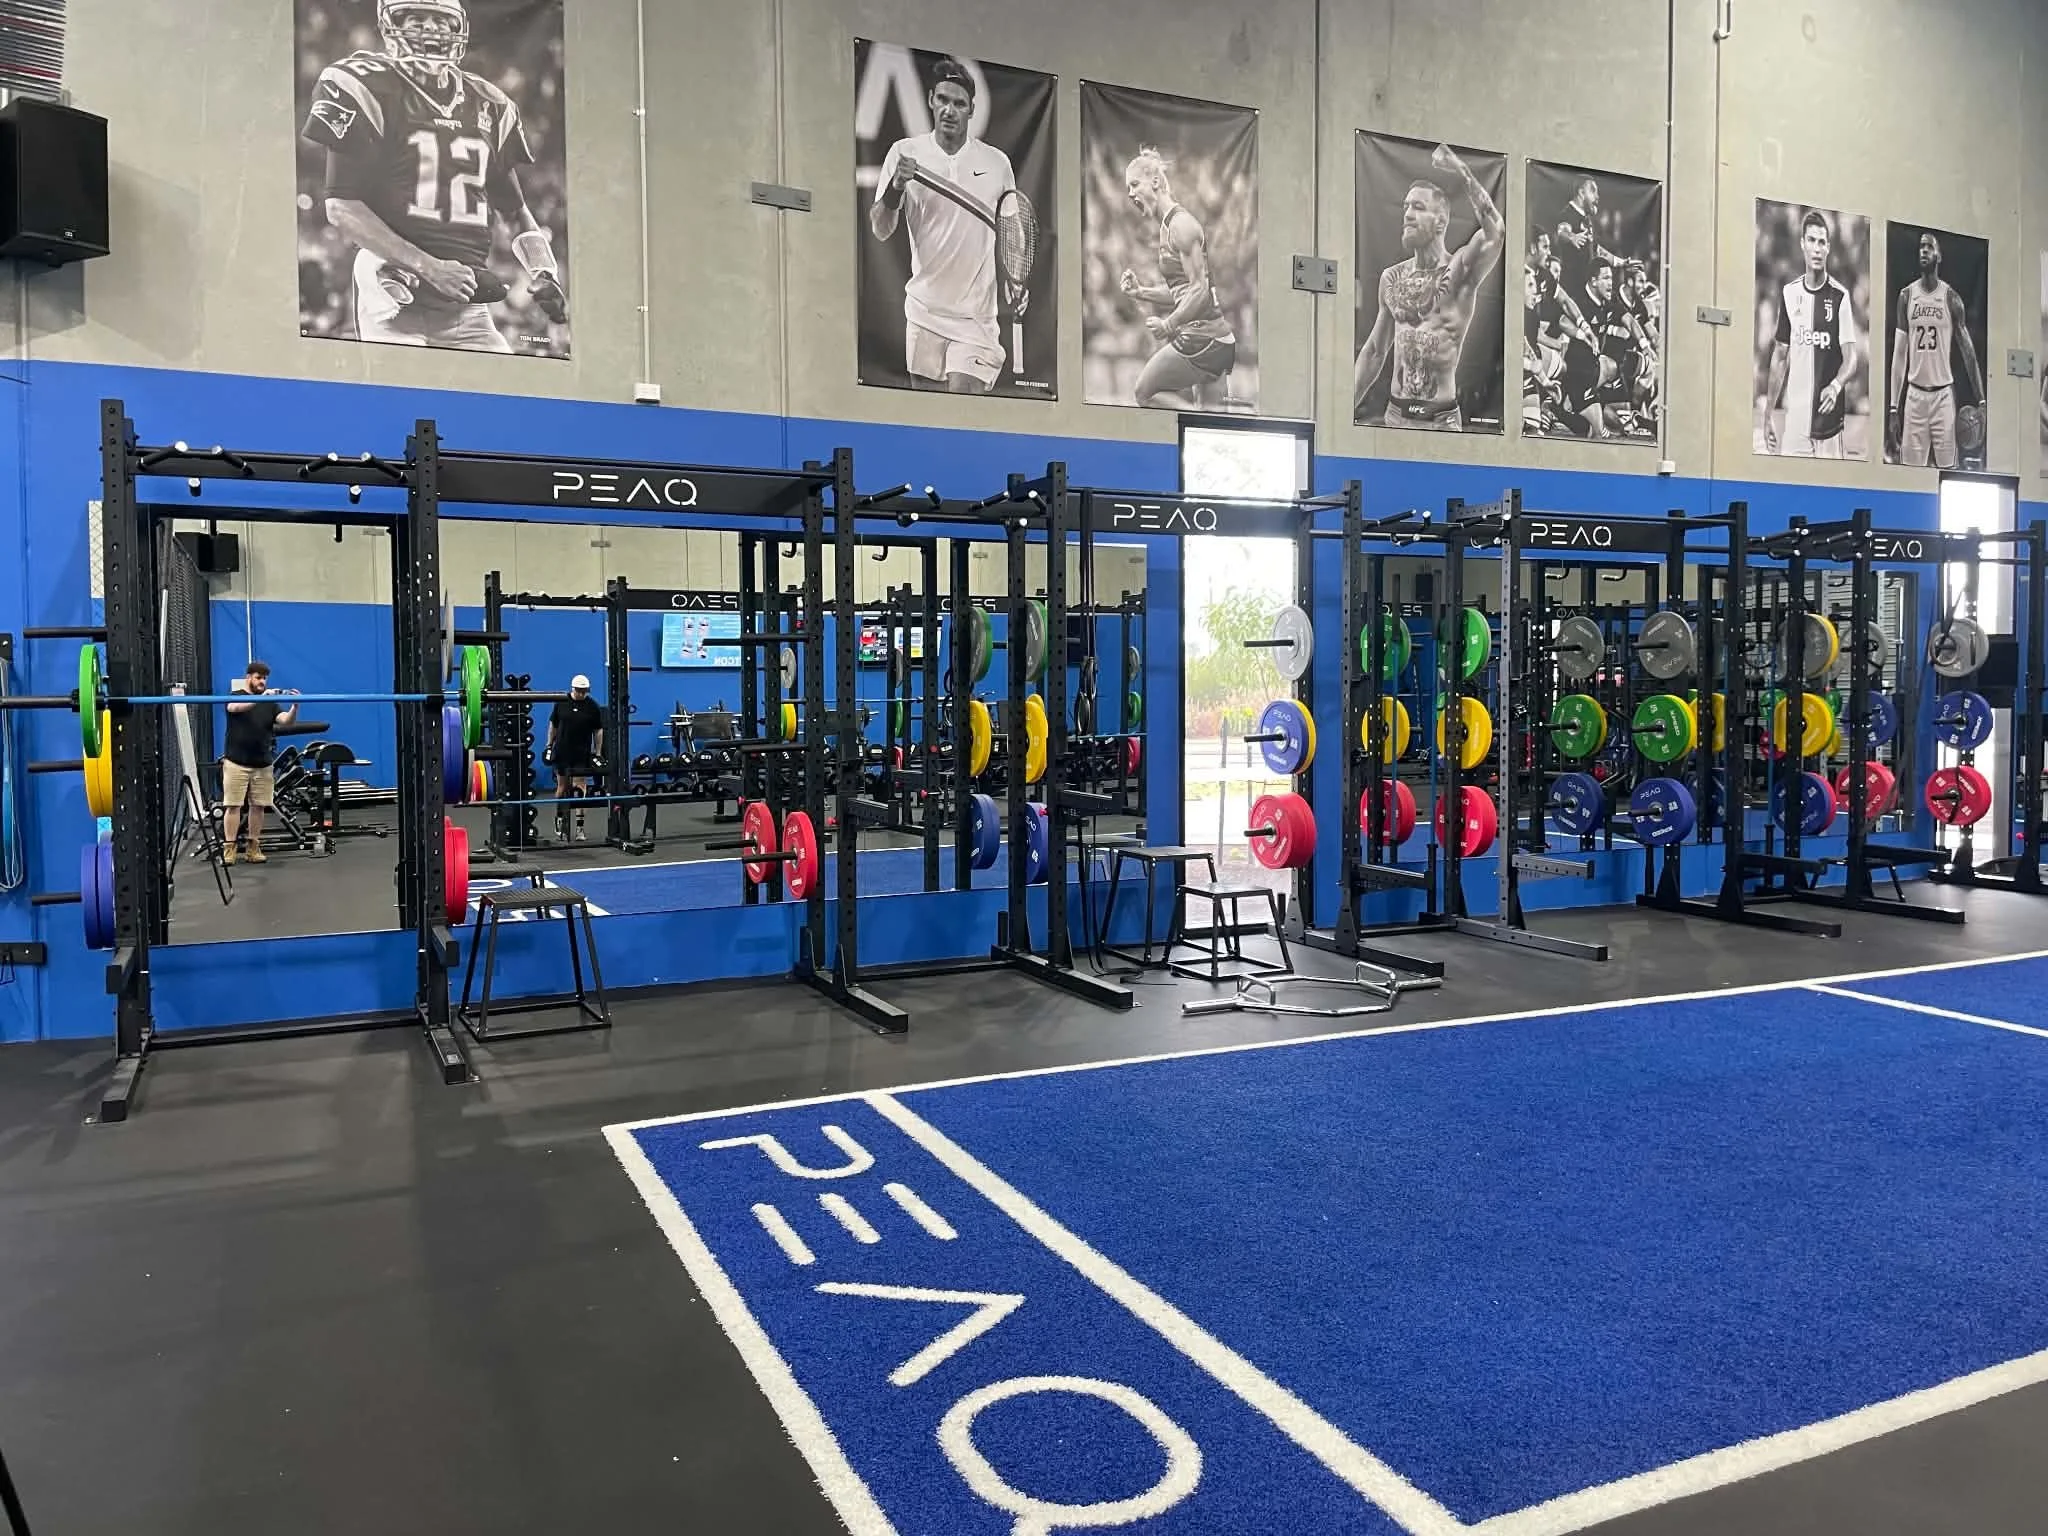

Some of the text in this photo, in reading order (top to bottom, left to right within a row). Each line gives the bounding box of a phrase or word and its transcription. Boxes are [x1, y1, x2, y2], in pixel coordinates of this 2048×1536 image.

[407, 130, 489, 228] 12
[1910, 302, 1944, 321] LAKERS
[1796, 326, 1831, 349] Jeep
[1916, 325, 1938, 351] 23
[552, 471, 698, 506] PEAQ
[1113, 503, 1217, 531] PEAQ
[1530, 522, 1612, 547] PEAQ
[697, 1123, 1204, 1536] PEAQ
